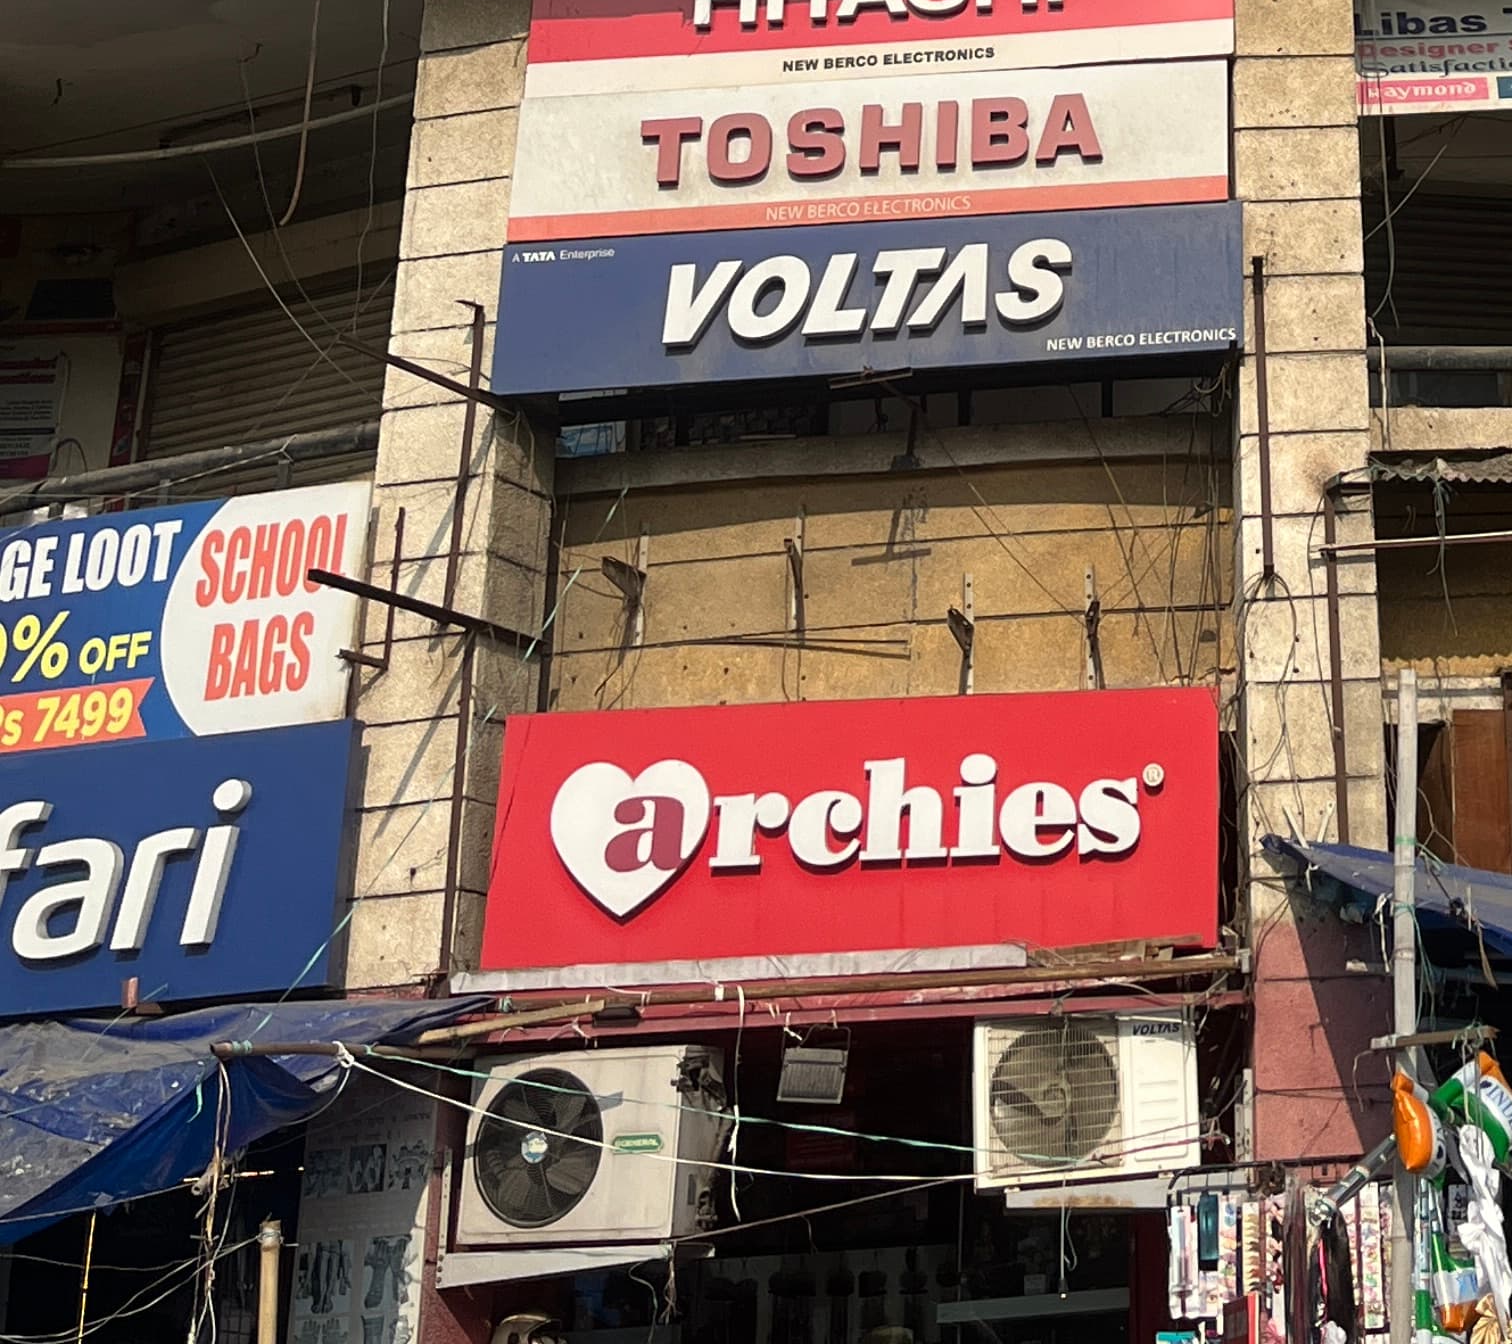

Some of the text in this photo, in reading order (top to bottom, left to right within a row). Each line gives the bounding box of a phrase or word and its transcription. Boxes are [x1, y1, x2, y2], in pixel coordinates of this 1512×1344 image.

[1355, 10, 1488, 37] Libas
[783, 46, 996, 73] NEW BERCO ELECTRONICS
[1357, 41, 1499, 60] Designer
[640, 93, 1104, 188] TOSHIBA
[765, 195, 971, 222] NEW BERCO ELECTRONICS
[512, 247, 615, 263] A TATA Enterprise
[661, 238, 1074, 350] VOLTAS
[1046, 327, 1237, 352] NEW BERCO ELECTRONICS
[61, 519, 183, 596] LOOT
[196, 512, 350, 609] SCHOOL
[78, 630, 153, 676] OFF
[204, 610, 315, 702] BAGS
[33, 685, 135, 744] 7499
[604, 752, 1142, 875] archies
[1131, 1021, 1182, 1038] VOLTAS
